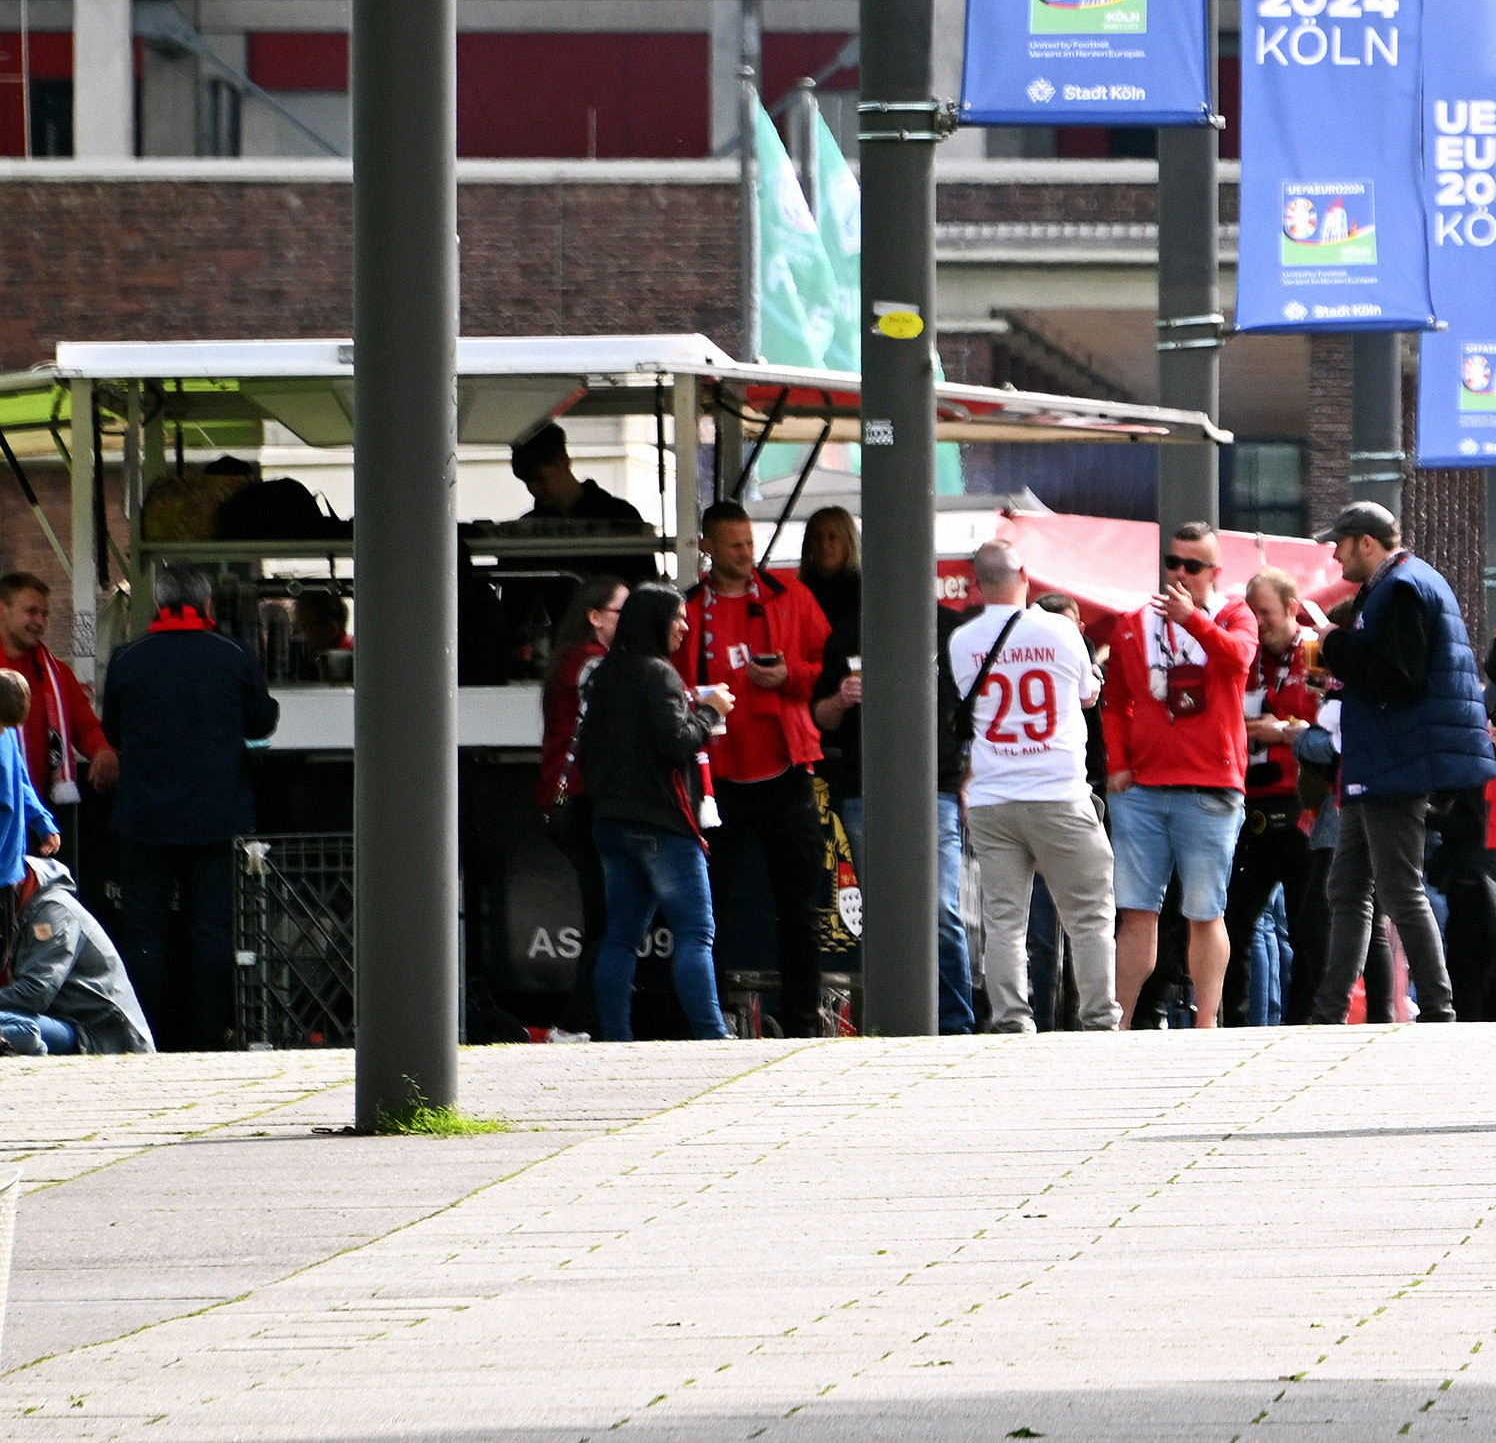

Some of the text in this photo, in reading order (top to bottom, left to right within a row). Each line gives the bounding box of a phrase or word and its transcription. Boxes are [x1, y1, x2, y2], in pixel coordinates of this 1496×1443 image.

[1256, 18, 1400, 67] KÖLN
[1063, 84, 1146, 101] Stadt Köln
[1353, 303, 1382, 317] Köln
[976, 669, 1057, 744] 29
